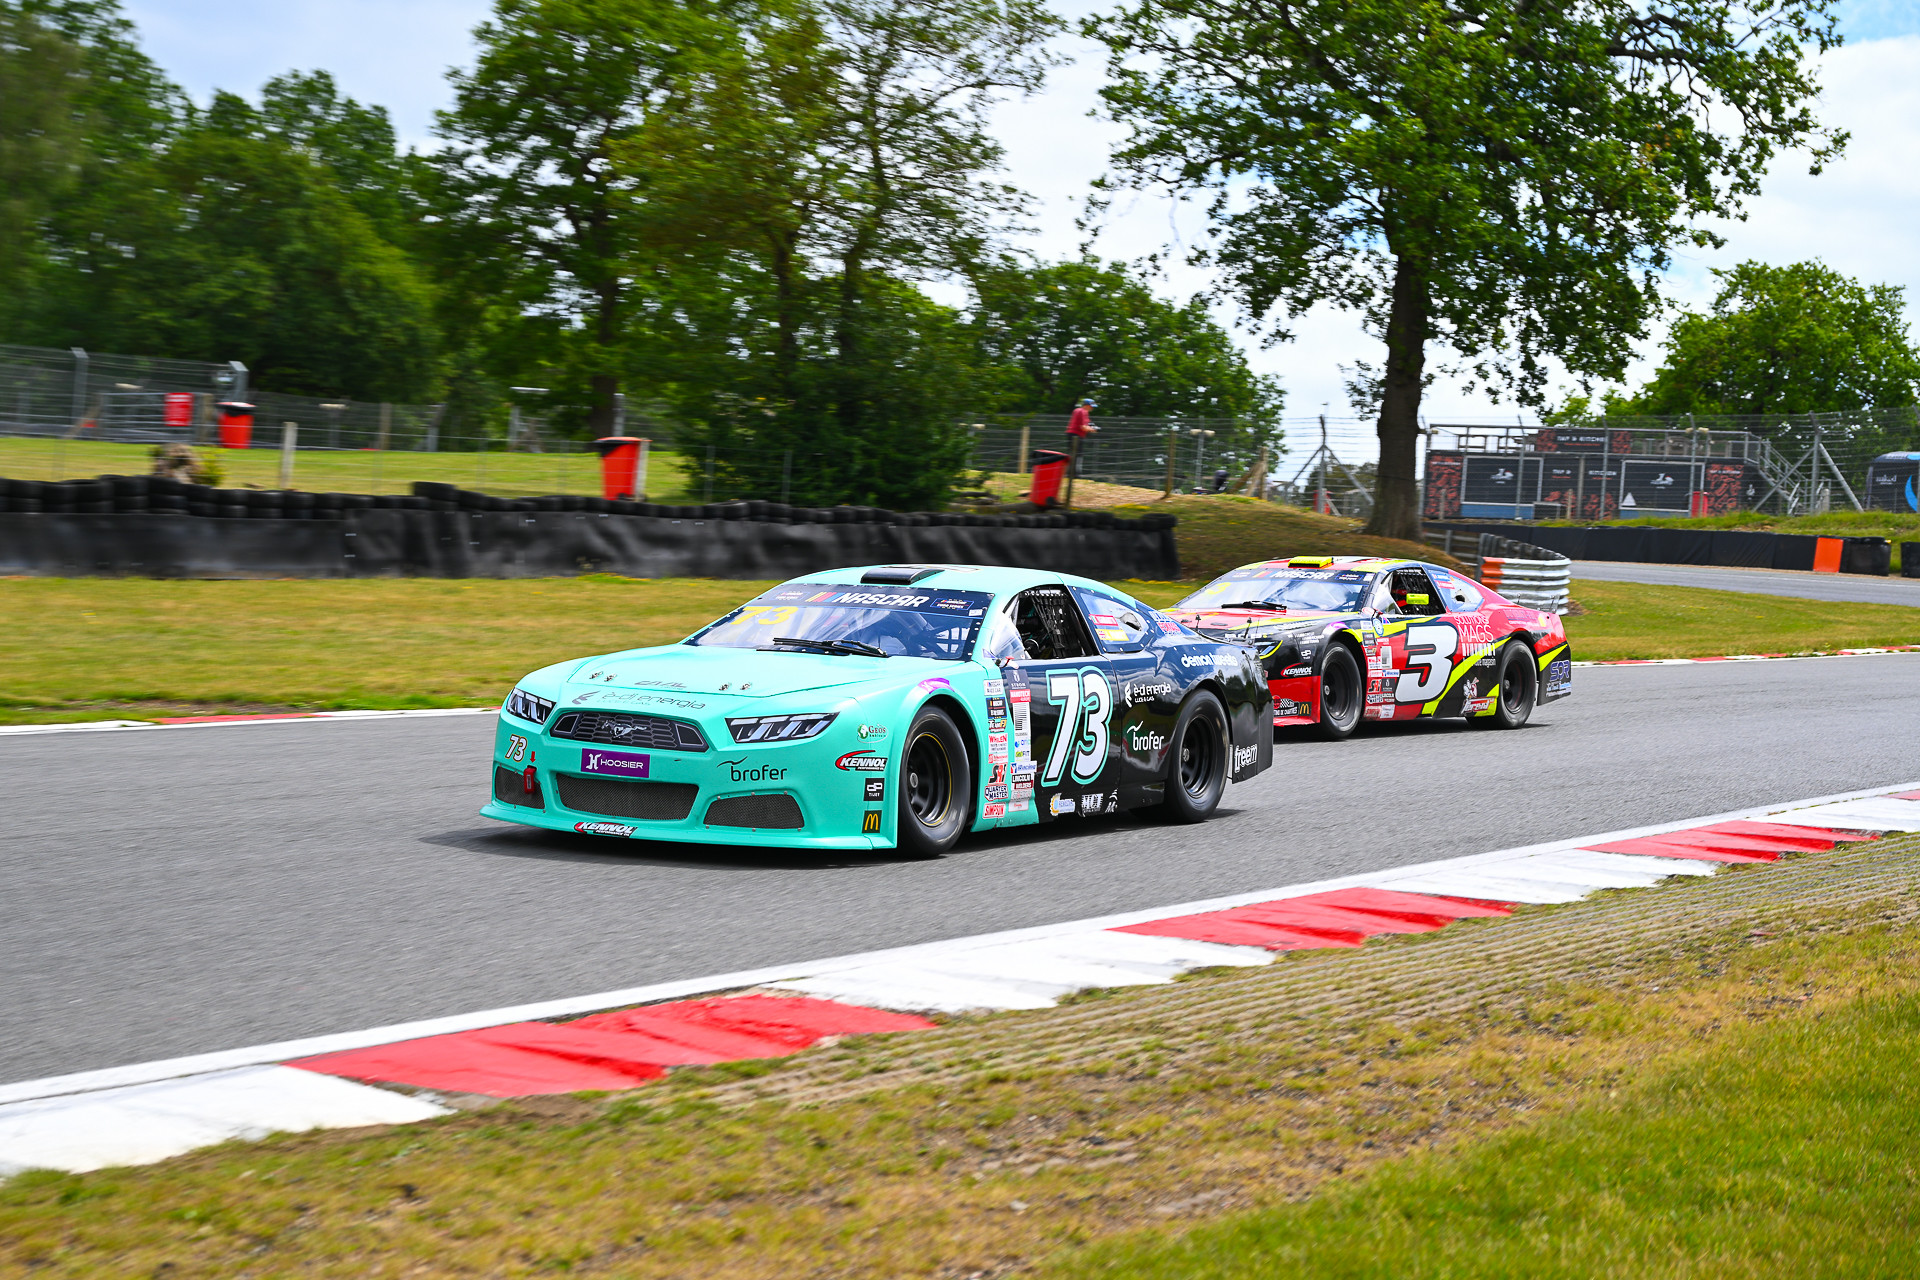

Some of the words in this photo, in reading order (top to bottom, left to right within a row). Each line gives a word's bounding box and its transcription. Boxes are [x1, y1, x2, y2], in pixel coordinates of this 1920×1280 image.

[1270, 570, 1334, 580] NASCAR
[1206, 582, 1231, 595] 3
[832, 592, 930, 608] NASCAR
[730, 606, 798, 625] 73
[1458, 625, 1494, 642] MAGS
[1181, 653, 1210, 668] demon
[1395, 623, 1459, 704] 3
[1283, 667, 1312, 676] KENNOL
[1550, 660, 1571, 681] SOR
[637, 694, 706, 710] energia
[1042, 667, 1113, 786] 73
[505, 734, 528, 762] 73
[1132, 730, 1165, 751] brofer
[600, 758, 644, 770] HOOSIER
[840, 757, 886, 767] KENNOL
[1234, 744, 1258, 774] freem
[730, 764, 788, 782] brofer
[984, 805, 1004, 816] SIMPSON
[578, 822, 634, 834] KENNOL
